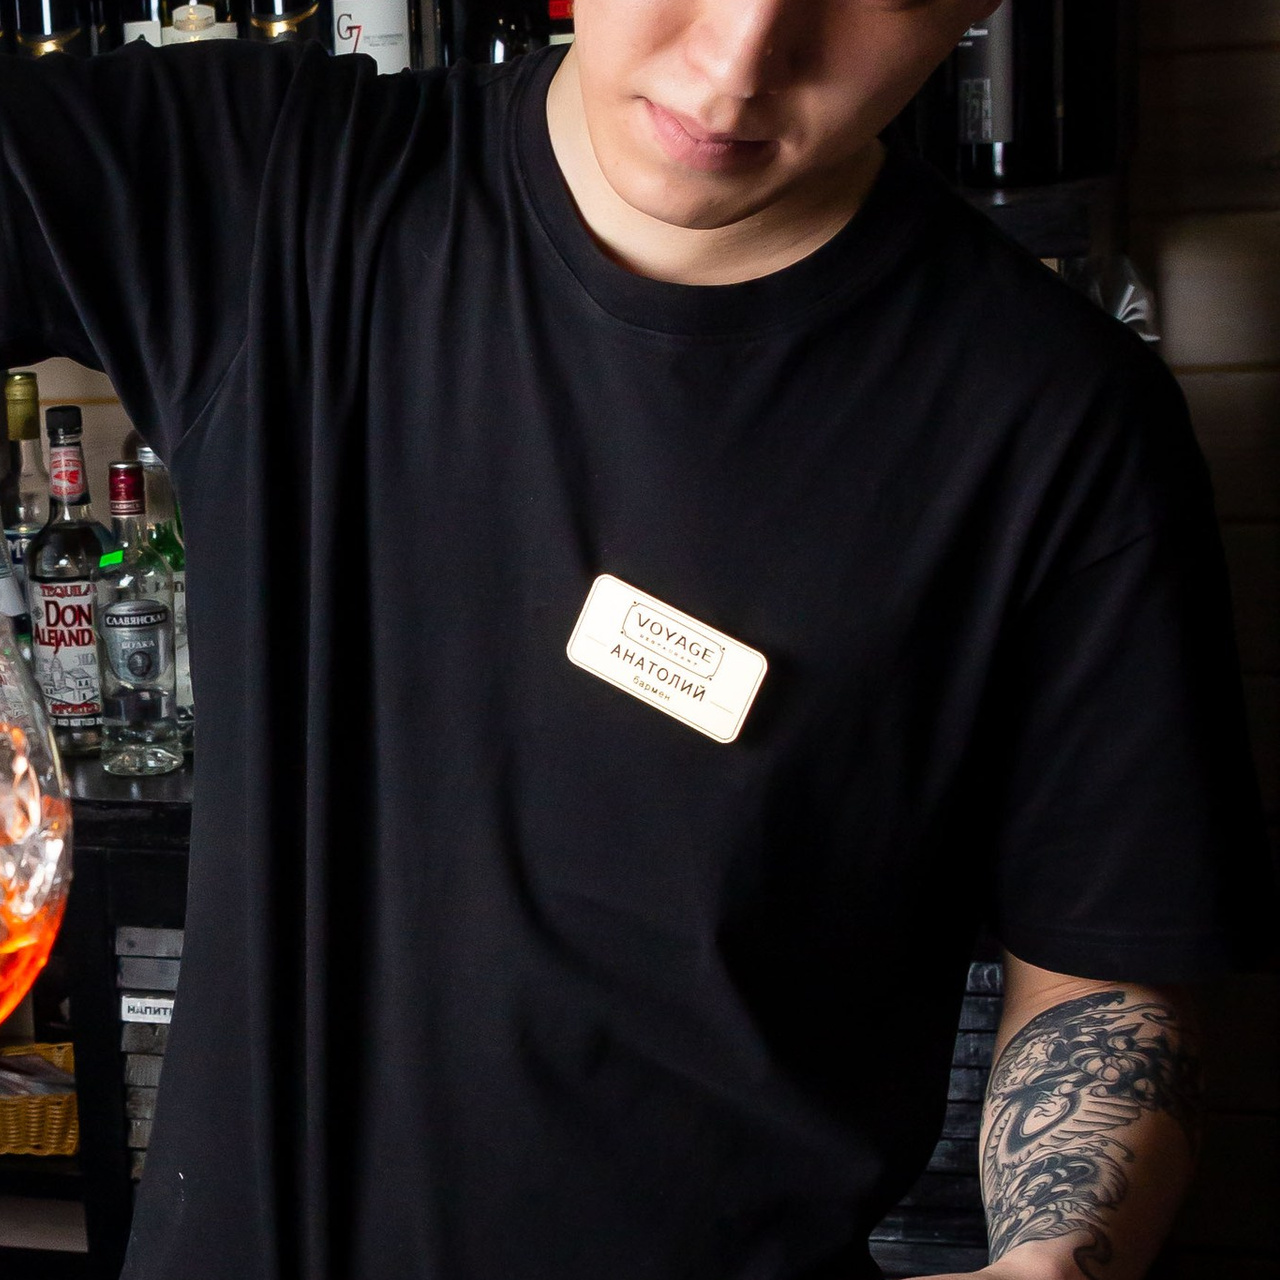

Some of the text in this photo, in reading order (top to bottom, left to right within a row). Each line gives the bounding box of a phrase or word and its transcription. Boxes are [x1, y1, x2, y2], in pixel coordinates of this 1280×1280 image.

[44, 600, 93, 628] DON
[637, 612, 715, 664] VOYAGE
[610, 643, 707, 702] АНАТОЛИЙ
[632, 674, 672, 701] бармен
[127, 1005, 173, 1016] НАПИТ
